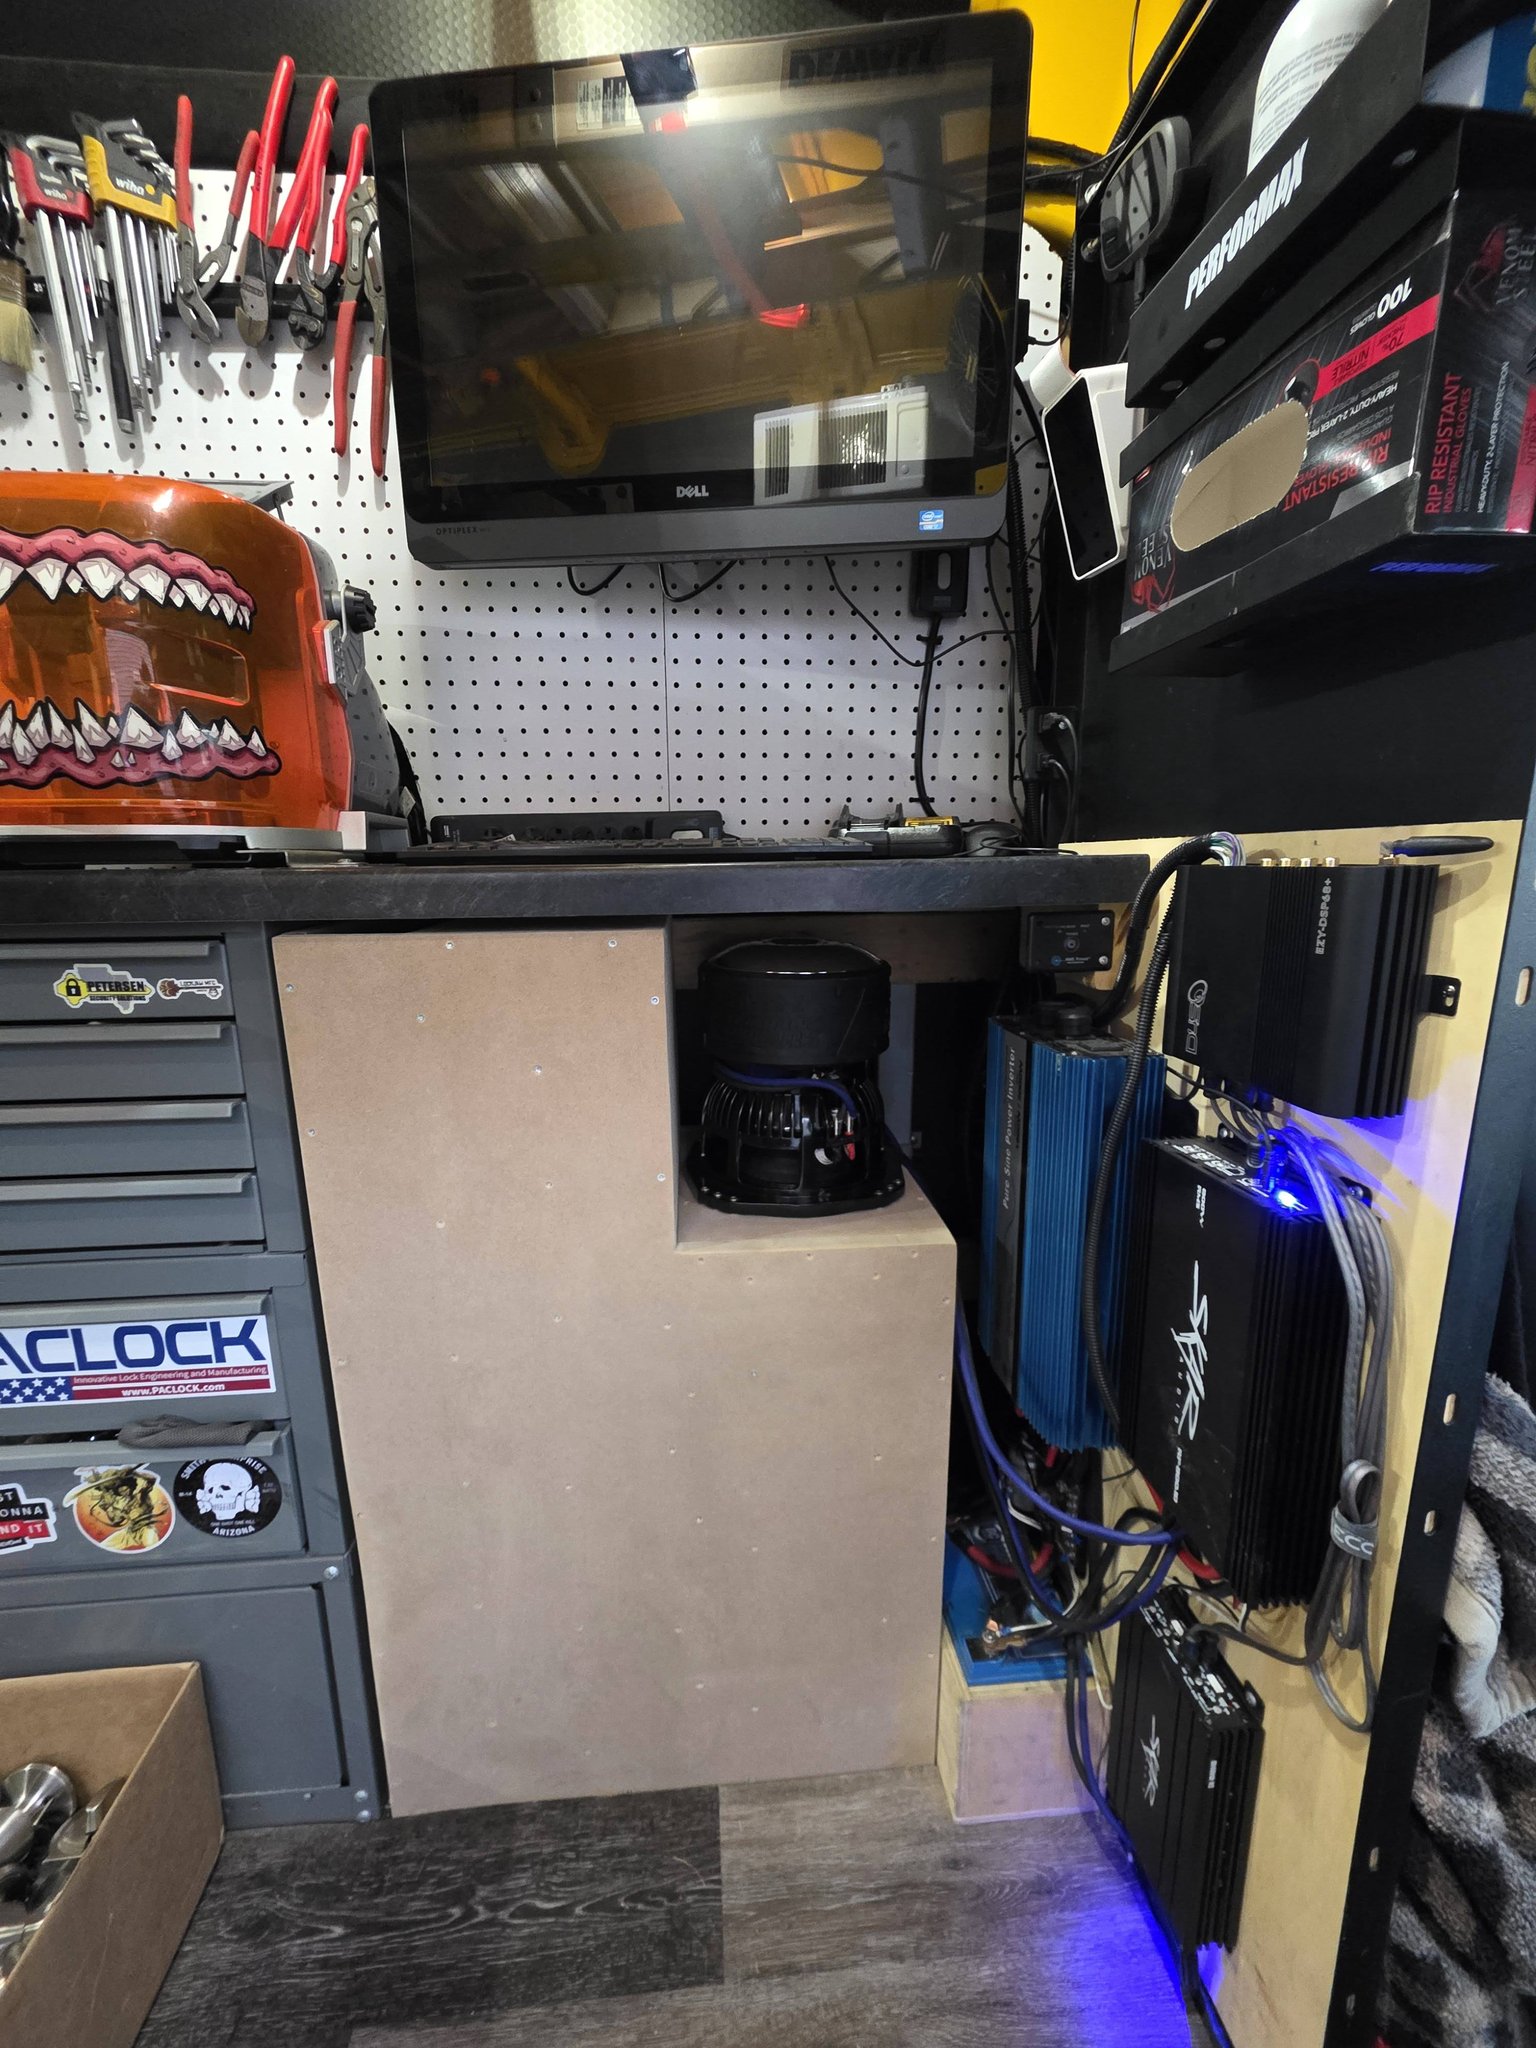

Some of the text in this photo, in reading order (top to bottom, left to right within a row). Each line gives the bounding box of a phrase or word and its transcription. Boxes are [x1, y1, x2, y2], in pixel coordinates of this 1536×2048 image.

[44, 188, 68, 201] wiha
[116, 177, 145, 196] wiha
[1184, 137, 1309, 310] PERFORMAX
[1377, 275, 1412, 319] 100
[1331, 346, 1370, 382] NITRILE
[1493, 361, 1510, 422] PROTECTION
[1424, 372, 1462, 514] RIP RESISTANT
[1443, 441, 1462, 513] INDUSTRIAL
[1455, 387, 1472, 437] GLOVES
[676, 485, 709, 498] DELL
[1282, 462, 1358, 512] RESISTANT
[436, 526, 477, 536] OPTIPLEX
[87, 981, 145, 993] PETERSEN
[1007, 1047, 1015, 1100] Inverter
[1005, 1103, 1013, 1146] Power
[1002, 1182, 1010, 1210] Pure
[73, 1365, 266, 1385] Innovative Lock Engineering and Manufacturing
[121, 1382, 225, 1397] www.PACLOCK.com
[1174, 1356, 1184, 1424] AUDIO
[28, 1523, 43, 1533] IT
[212, 1525, 255, 1537] ARIZONA
